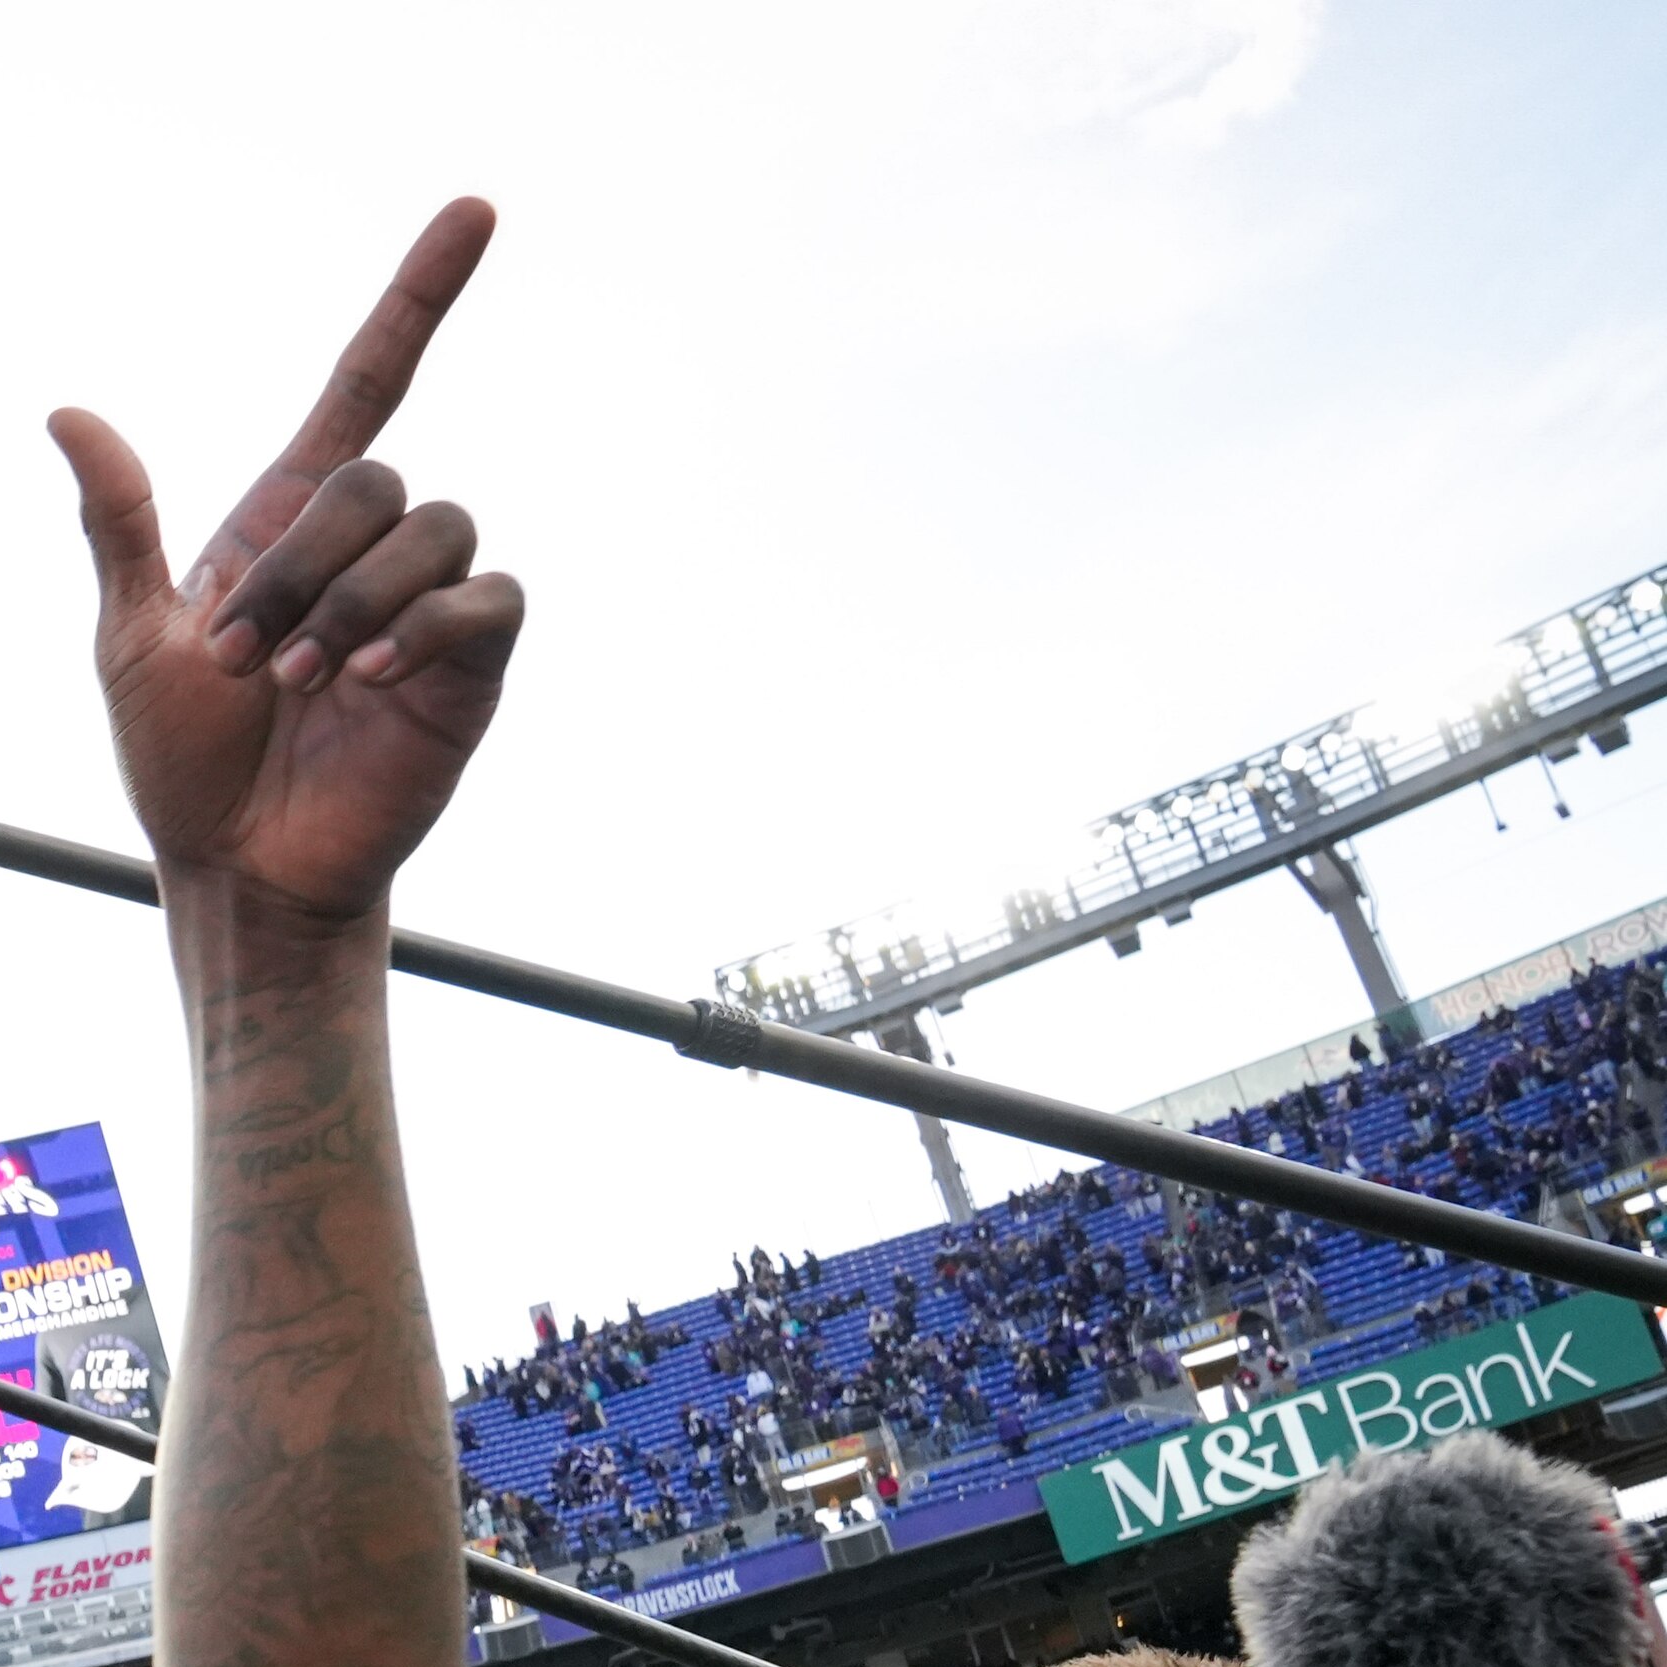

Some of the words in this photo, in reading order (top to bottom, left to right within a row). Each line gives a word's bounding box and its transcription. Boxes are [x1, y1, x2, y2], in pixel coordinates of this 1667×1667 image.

[1, 1249, 114, 1293] DIVISION
[70, 1368, 86, 1390] A
[89, 1367, 150, 1390] LOCK
[1092, 1391, 1328, 1541] M&T
[1336, 1322, 1597, 1454] Bank
[33, 1547, 152, 1584] FLAVOR
[28, 1573, 113, 1603] ZONE
[620, 1568, 741, 1618] RAVENSFLOCK
